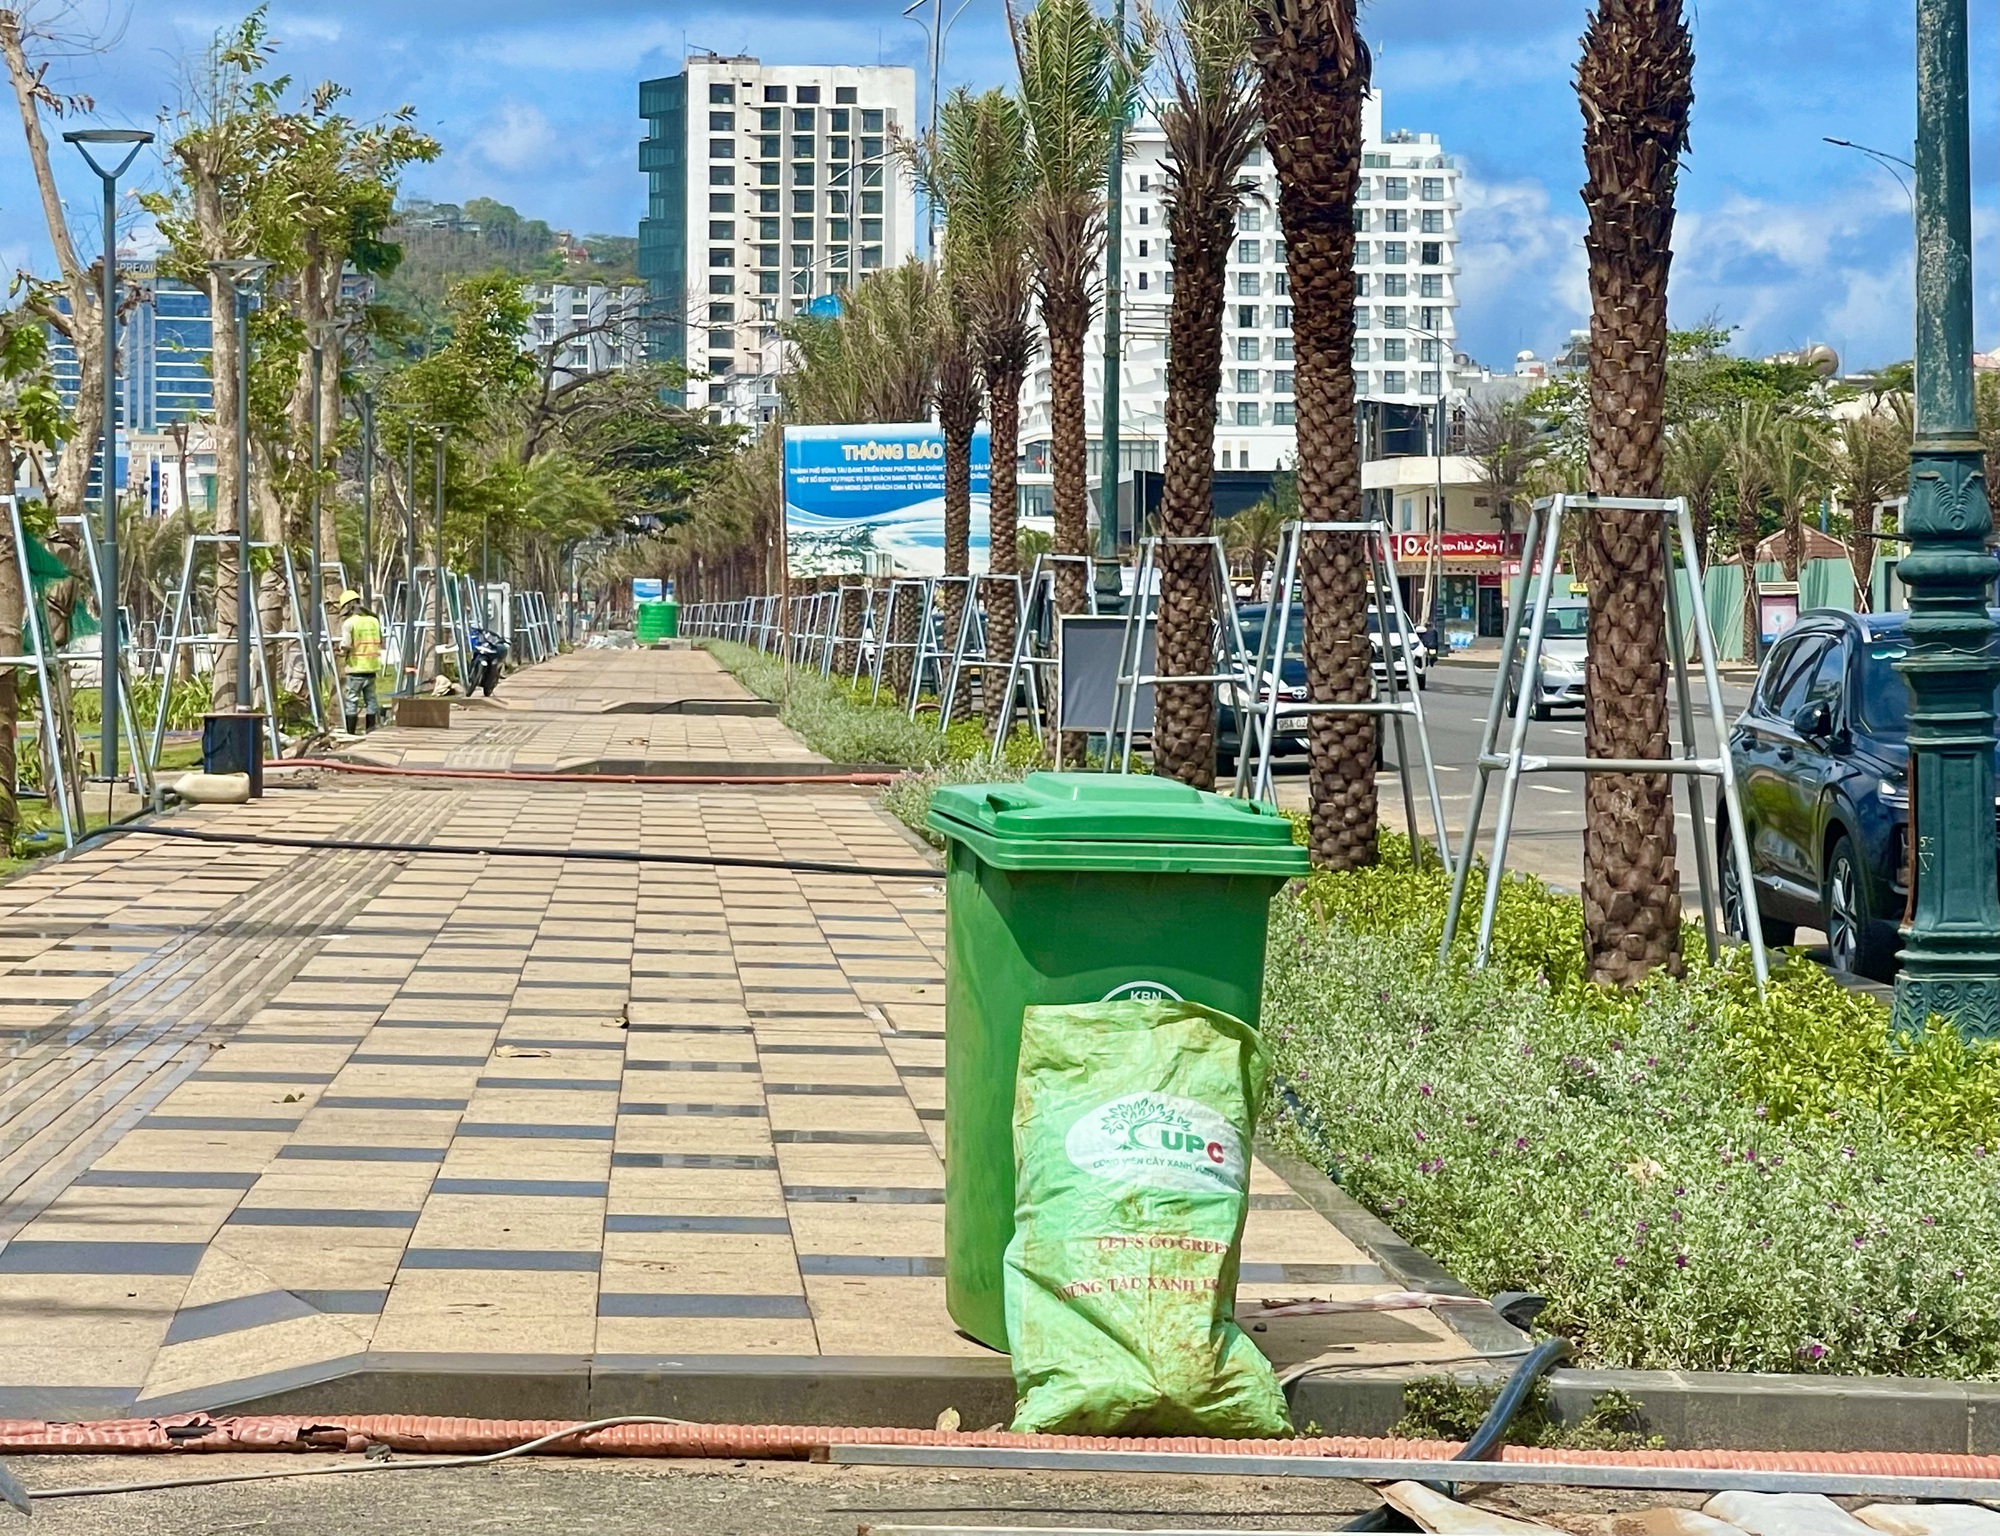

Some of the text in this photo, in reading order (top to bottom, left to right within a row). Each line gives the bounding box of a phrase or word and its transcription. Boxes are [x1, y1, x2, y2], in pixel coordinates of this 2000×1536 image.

[119, 262, 157, 274] PREMI
[842, 440, 943, 460] THÔNG BÁO
[1161, 1130, 1224, 1164] UPC
[1166, 1159, 1193, 1170] XANH
[1149, 1235, 1175, 1249] GO
[1147, 1277, 1195, 1292] XANH
